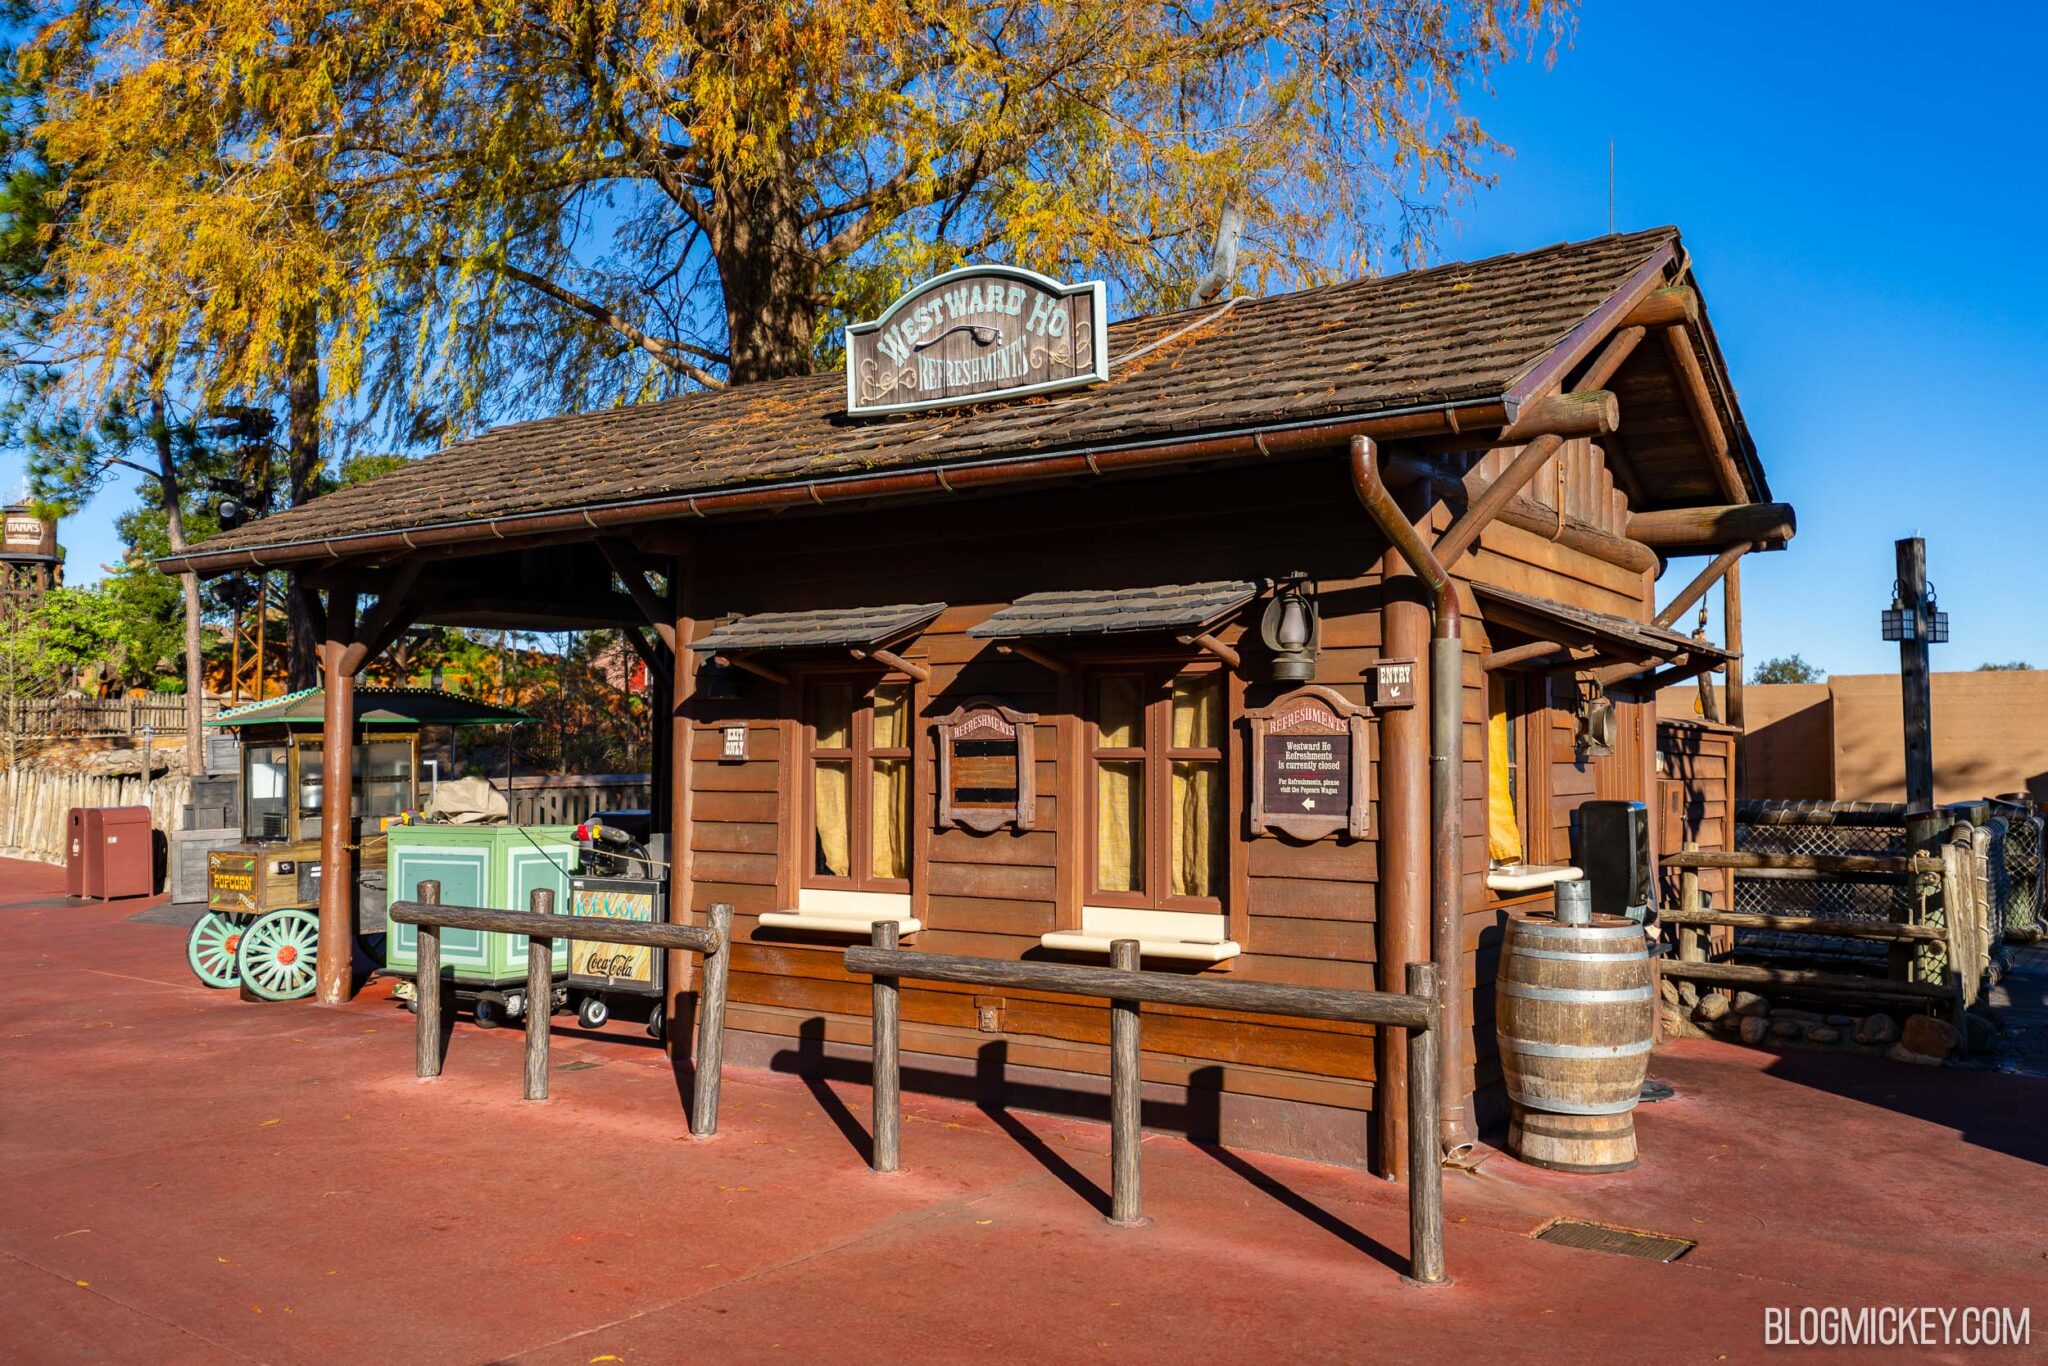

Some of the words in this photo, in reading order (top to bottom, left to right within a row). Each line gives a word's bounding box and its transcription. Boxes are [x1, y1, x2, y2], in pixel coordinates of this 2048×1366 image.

[876, 284, 1027, 367] WESTWARD
[1025, 292, 1068, 338] HO
[918, 335, 1029, 391] REFRESHMENTS
[1380, 666, 1411, 684] ENTRY
[954, 714, 1016, 738] REFRESHMENTS
[1269, 708, 1348, 734] REFRESHMENTS
[1286, 741, 1321, 751] Westward
[1322, 741, 1332, 751] Ho
[1285, 751, 1333, 760] Refreshments
[1278, 760, 1285, 770] is
[1286, 761, 1318, 772] currently
[1318, 760, 1340, 770] closed
[1300, 787, 1321, 795] Popcorn
[1321, 787, 1338, 795] Wagon
[1323, 778, 1340, 786] please
[213, 874, 252, 891] POPCORN
[575, 893, 602, 917] ICE
[586, 952, 635, 978] Coca-Cola
